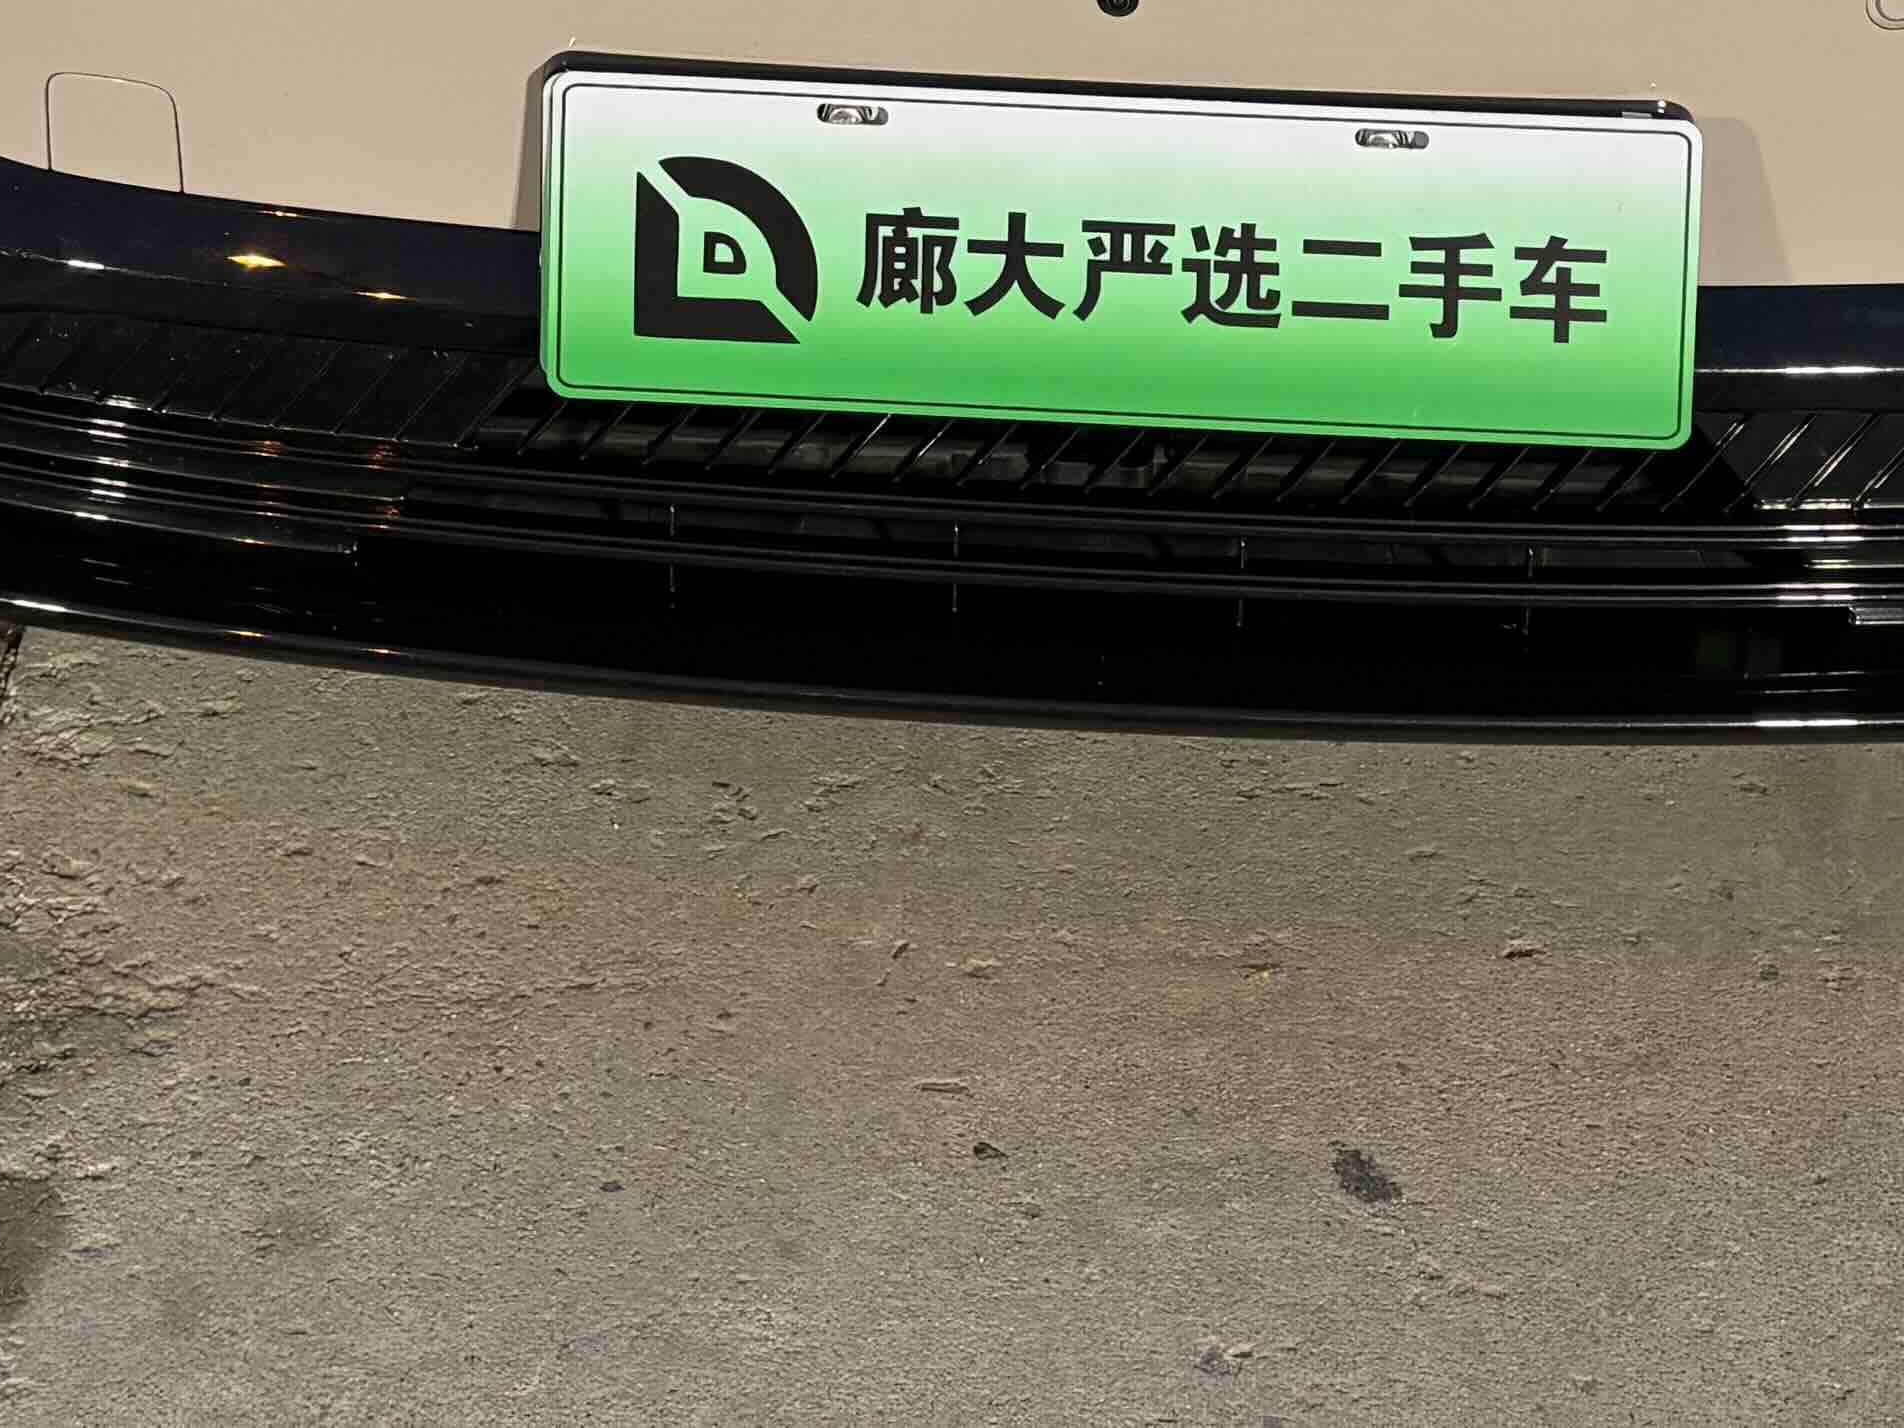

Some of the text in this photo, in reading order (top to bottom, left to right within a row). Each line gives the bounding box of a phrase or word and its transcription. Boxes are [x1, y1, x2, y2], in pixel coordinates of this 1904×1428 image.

[854, 204, 1612, 346] 廊大严选二手车
